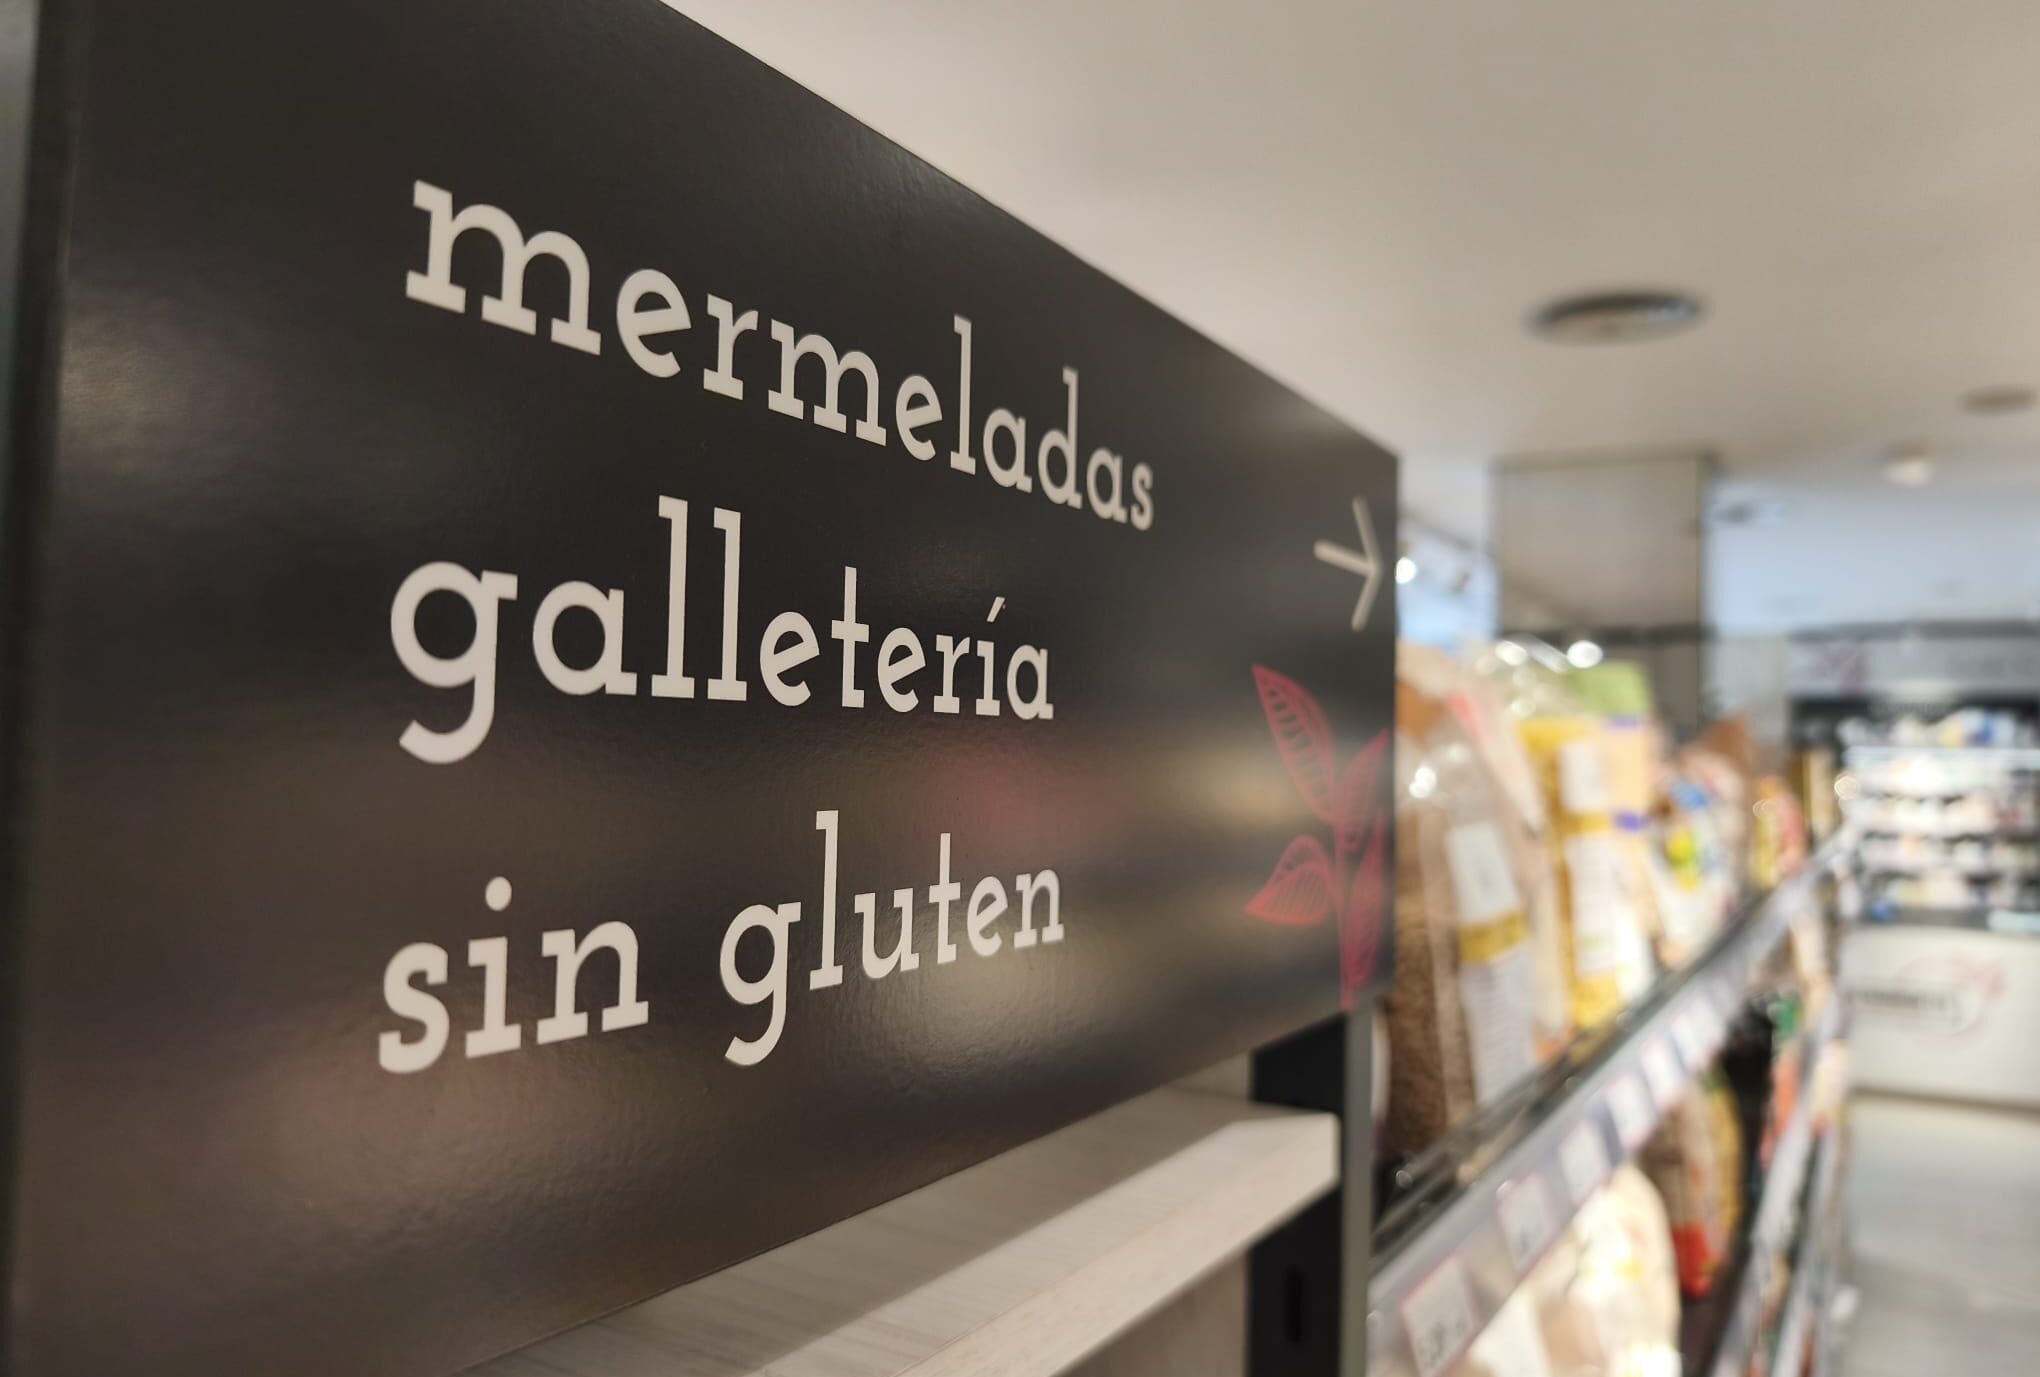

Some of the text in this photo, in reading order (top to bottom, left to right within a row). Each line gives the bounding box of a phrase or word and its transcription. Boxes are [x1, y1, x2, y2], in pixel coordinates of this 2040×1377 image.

[405, 179, 1155, 531] mermeladas
[389, 495, 1054, 763] galletería
[377, 809, 1065, 1073] sin gluten
